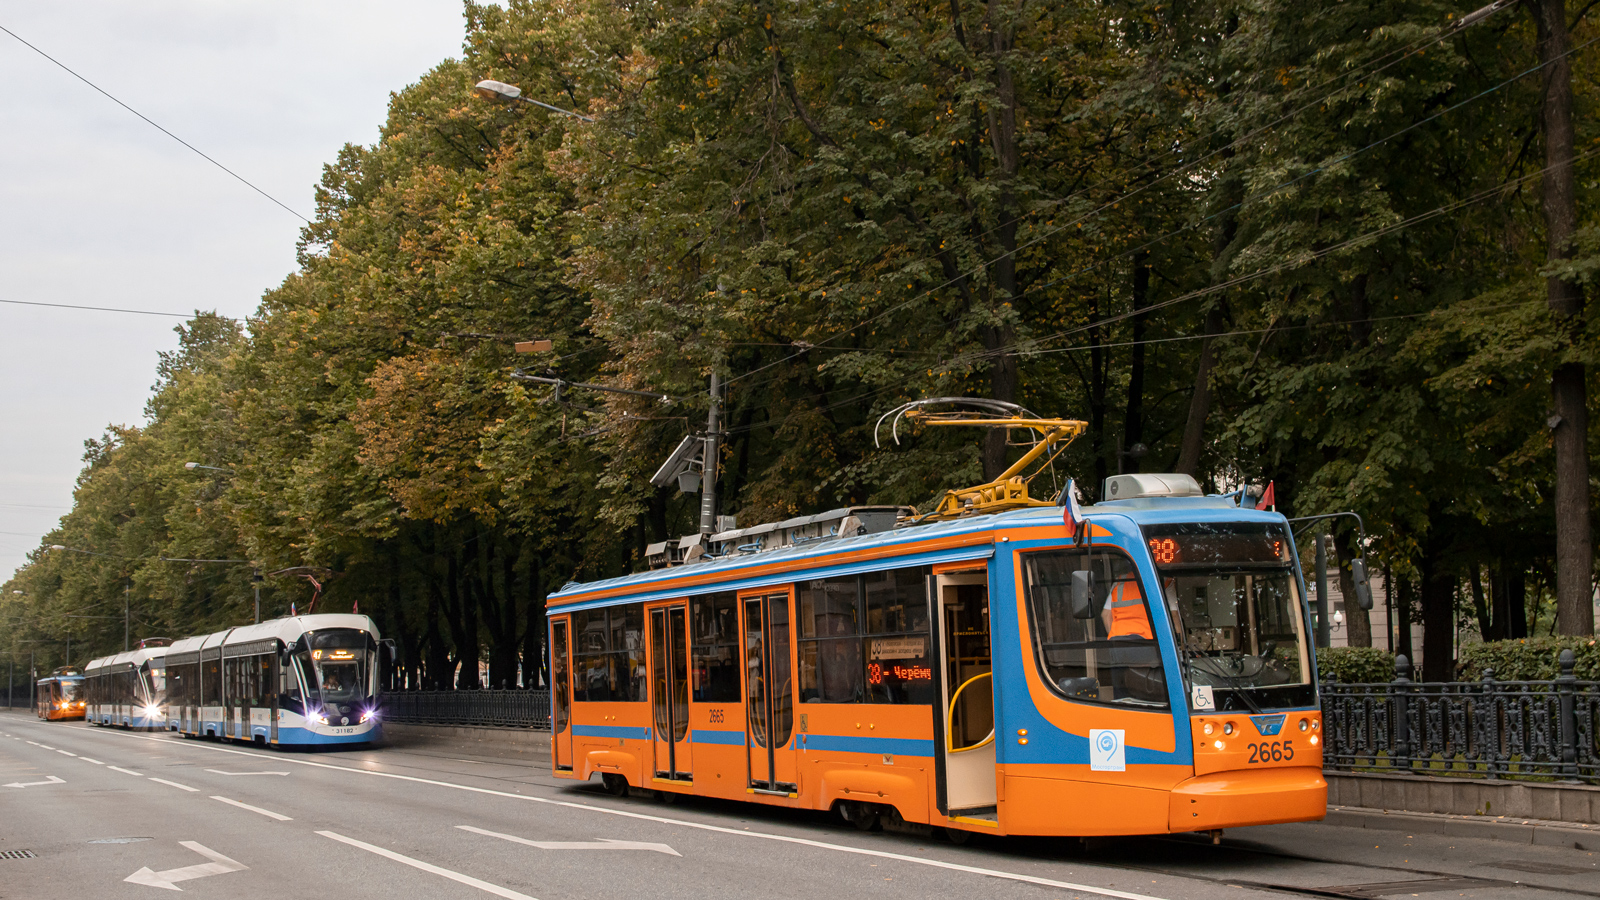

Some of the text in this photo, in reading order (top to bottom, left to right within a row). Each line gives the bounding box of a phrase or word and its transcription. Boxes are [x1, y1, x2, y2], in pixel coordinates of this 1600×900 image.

[1149, 538, 1174, 563] 38
[312, 650, 322, 660] 47
[868, 663, 881, 684] 38
[709, 709, 725, 723] 2665
[1247, 740, 1295, 764] 2665
